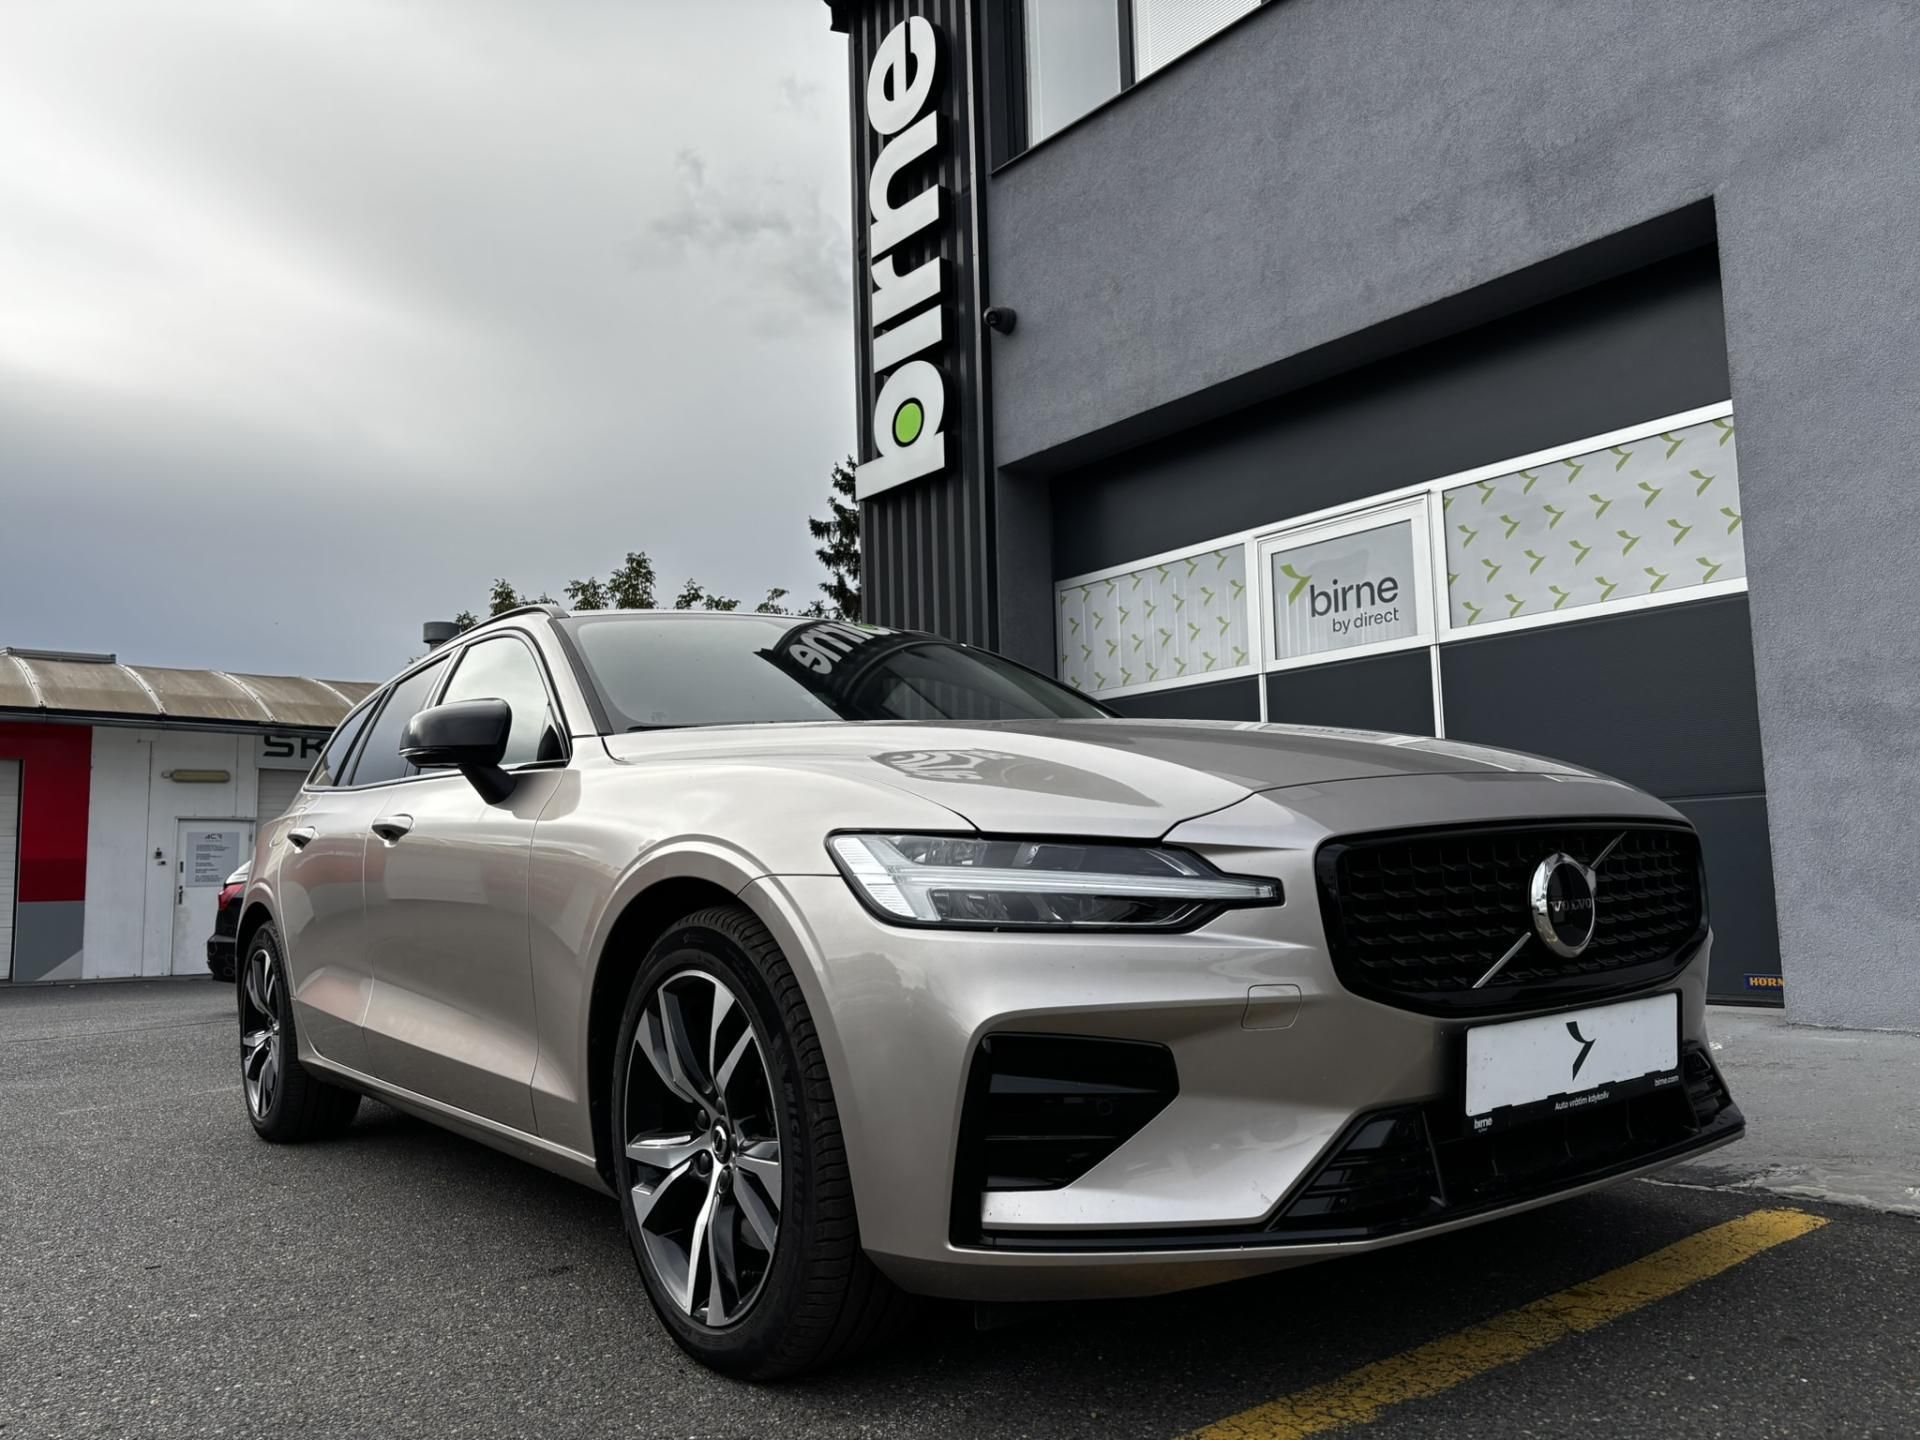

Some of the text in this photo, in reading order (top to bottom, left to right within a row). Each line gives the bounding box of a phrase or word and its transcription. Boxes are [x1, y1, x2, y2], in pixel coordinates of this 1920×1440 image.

[855, 15, 945, 501] birne
[1310, 577, 1399, 617] birne
[1332, 607, 1400, 635] by direct
[1554, 1101, 1569, 1111] Auto
